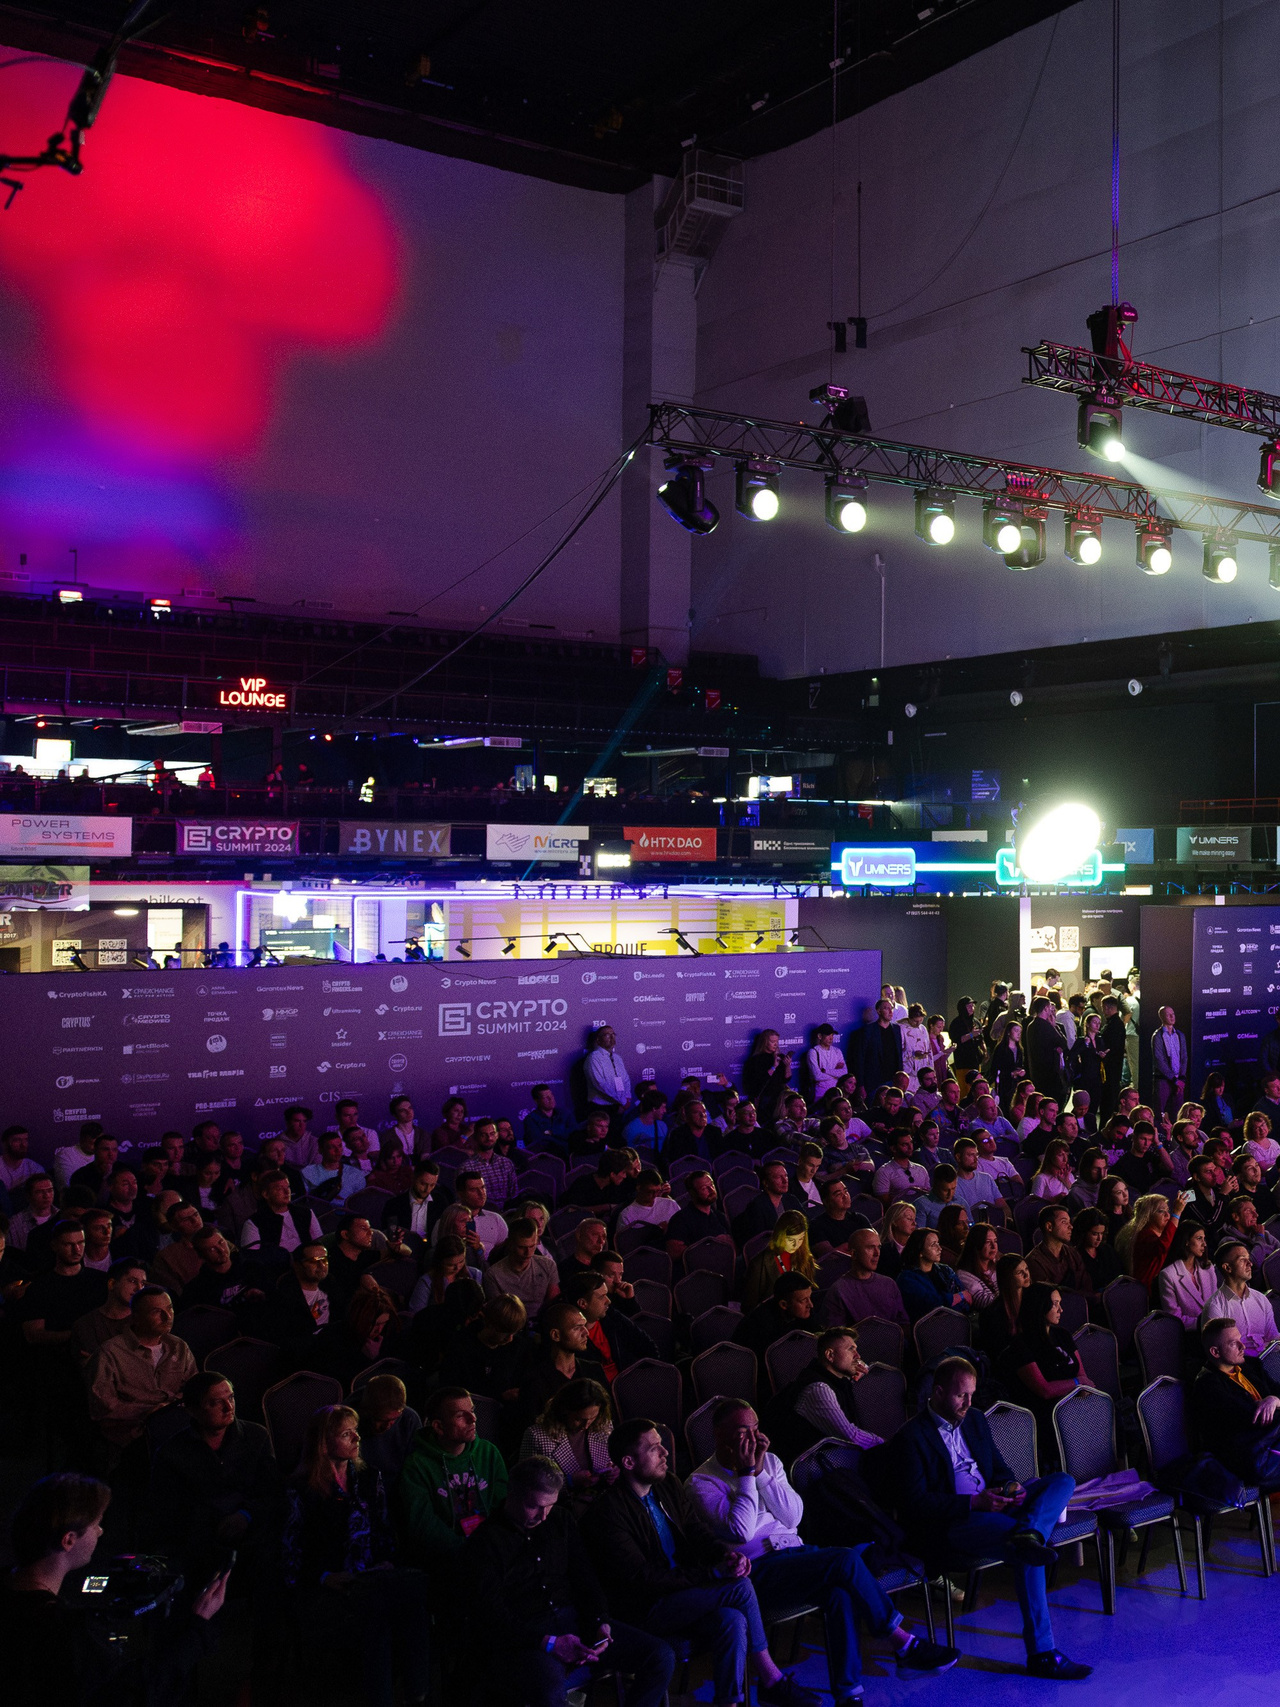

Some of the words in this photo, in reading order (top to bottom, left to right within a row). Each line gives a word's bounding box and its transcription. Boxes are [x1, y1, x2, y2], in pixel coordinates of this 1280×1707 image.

[240, 677, 267, 692] VIP
[219, 690, 287, 708] LOUNGE
[11, 818, 70, 828] POWER
[41, 831, 115, 840] SYSTEMS
[215, 826, 292, 840] CRYPTO
[348, 828, 441, 853] BYNEX
[651, 837, 675, 849] HTX
[677, 837, 702, 848] DAO
[1198, 836, 1239, 845] UMINERS
[216, 842, 261, 851] SUMMIT
[264, 843, 292, 851] 2024
[864, 863, 911, 875] UMINERS
[58, 990, 108, 998] CryptoFishKA
[476, 999, 568, 1019] CRYPTO
[477, 1022, 531, 1035] SUMMIT
[535, 1020, 568, 1032] 2024
[445, 1054, 491, 1063] CRYPTOVIEW
[335, 1062, 366, 1070] Crypto.ru
[265, 1096, 298, 1105] ALTCOIN
[319, 1091, 341, 1102] CIS
